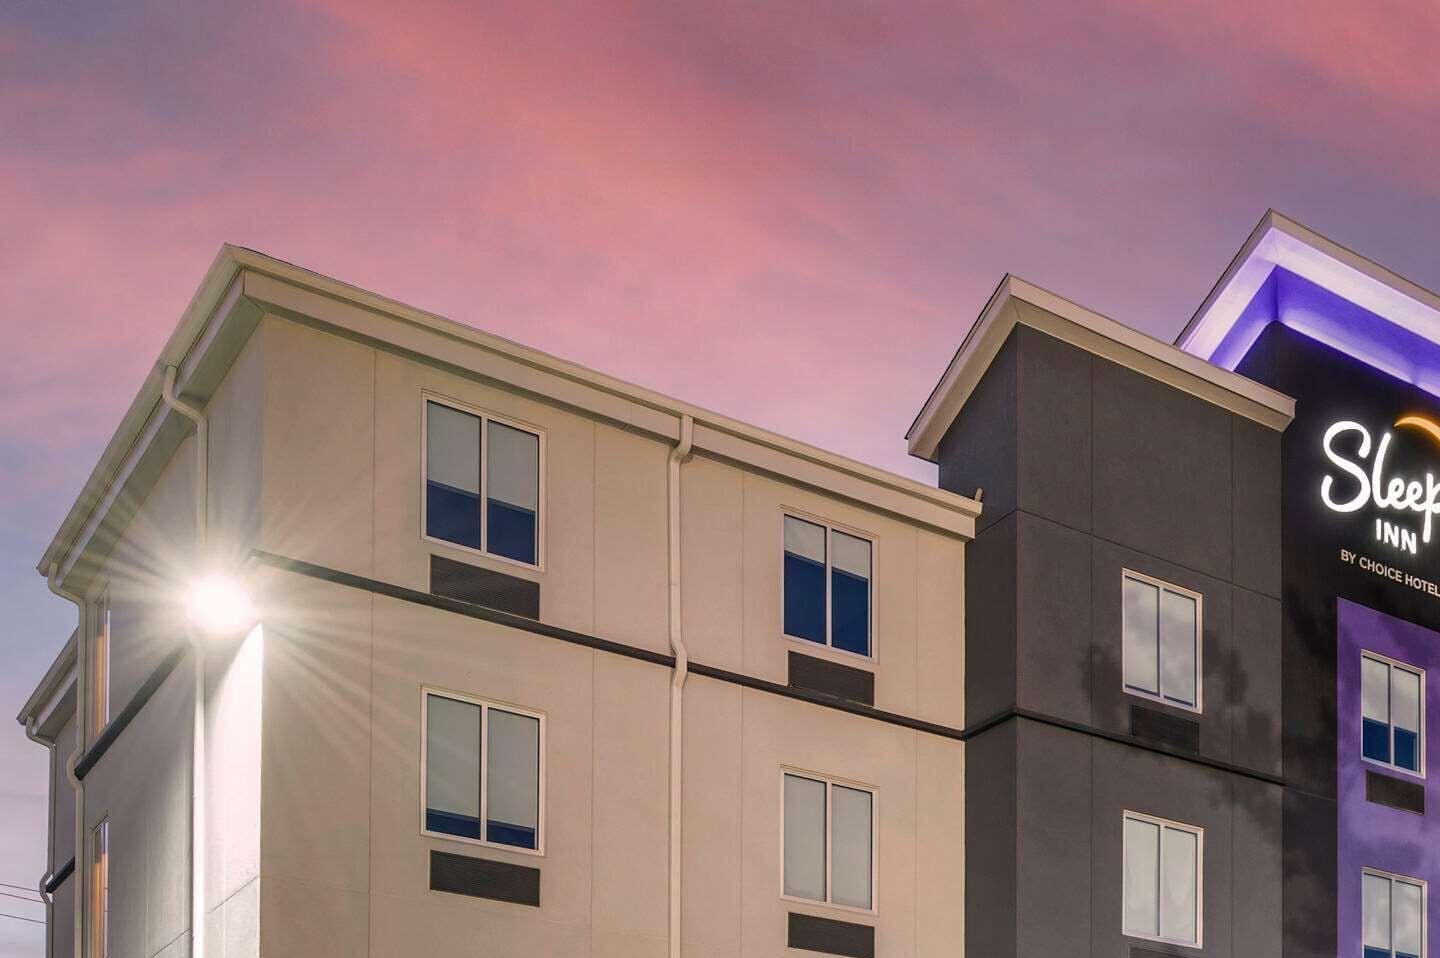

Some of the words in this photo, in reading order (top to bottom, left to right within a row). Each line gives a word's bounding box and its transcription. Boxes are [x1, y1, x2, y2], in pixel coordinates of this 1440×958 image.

[1375, 518, 1417, 555] INN
[1340, 549, 1357, 564] BY
[1359, 557, 1402, 583] CHOICE
